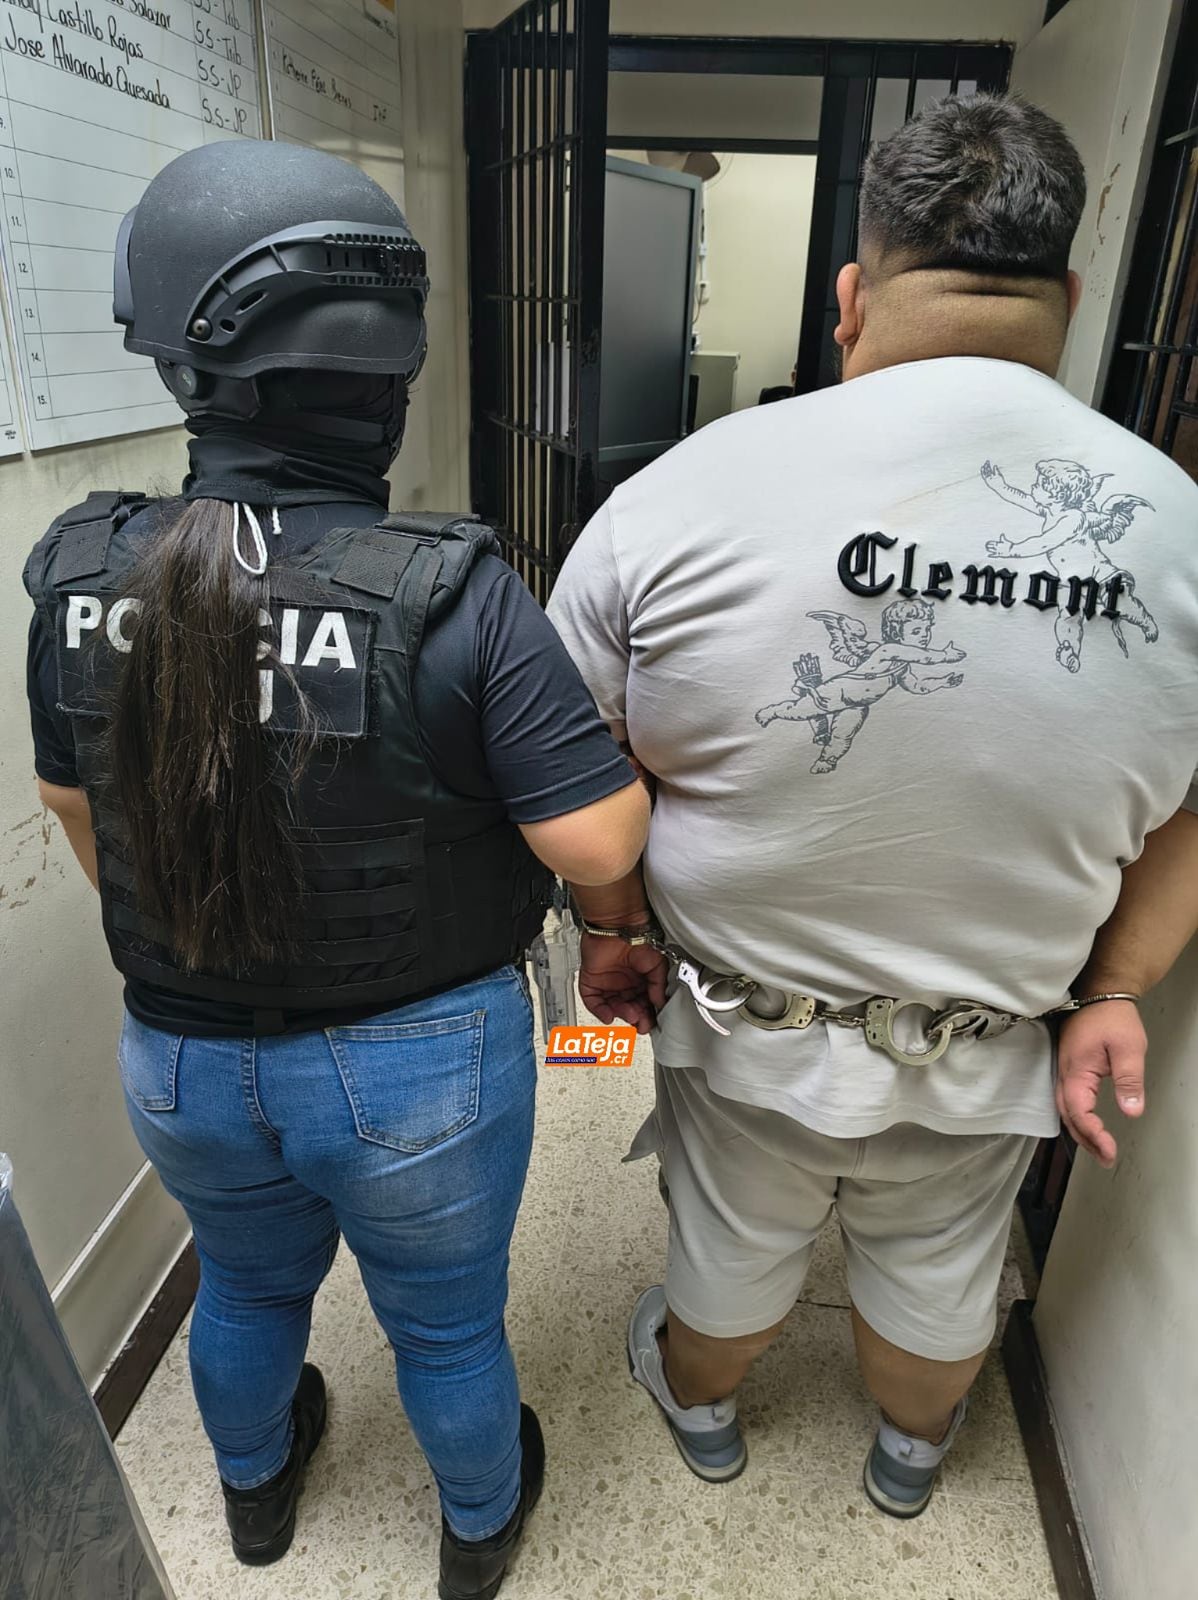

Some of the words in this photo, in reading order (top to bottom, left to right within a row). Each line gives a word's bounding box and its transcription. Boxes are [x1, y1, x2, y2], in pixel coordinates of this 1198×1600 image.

[5, 12, 46, 58] Jose
[52, 33, 113, 87] Alvarado
[116, 65, 171, 109] Quesada
[46, 0, 104, 41] Castillo
[107, 15, 144, 65] Rojas
[837, 531, 1125, 621] Clemont
[65, 595, 357, 669] POIA
